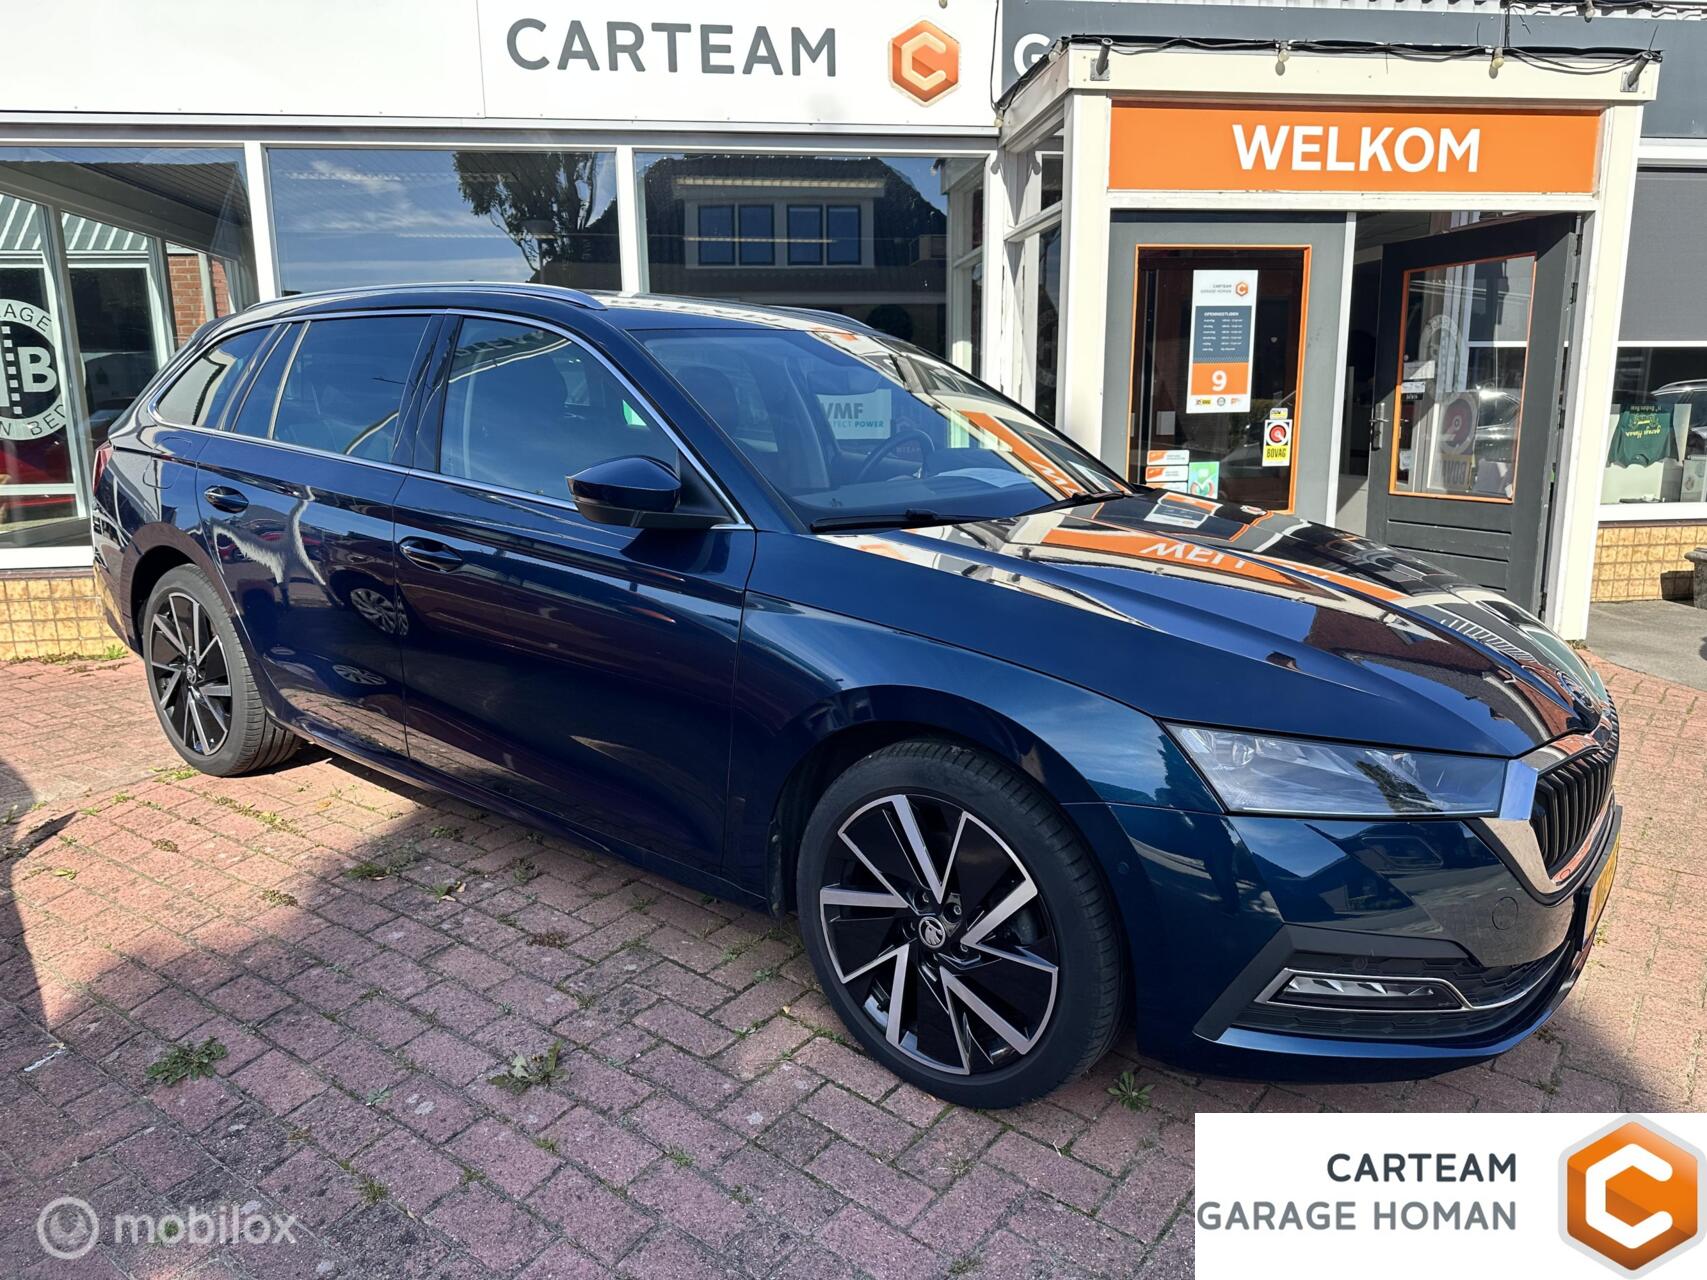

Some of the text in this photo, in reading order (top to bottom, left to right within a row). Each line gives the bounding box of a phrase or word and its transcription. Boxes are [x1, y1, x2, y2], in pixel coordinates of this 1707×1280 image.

[506, 17, 837, 78] CARTEAM
[1231, 123, 1480, 174] WELKOM
[0, 303, 52, 332] AGE
[1211, 369, 1228, 392] 9
[1266, 448, 1286, 458] BOVAG
